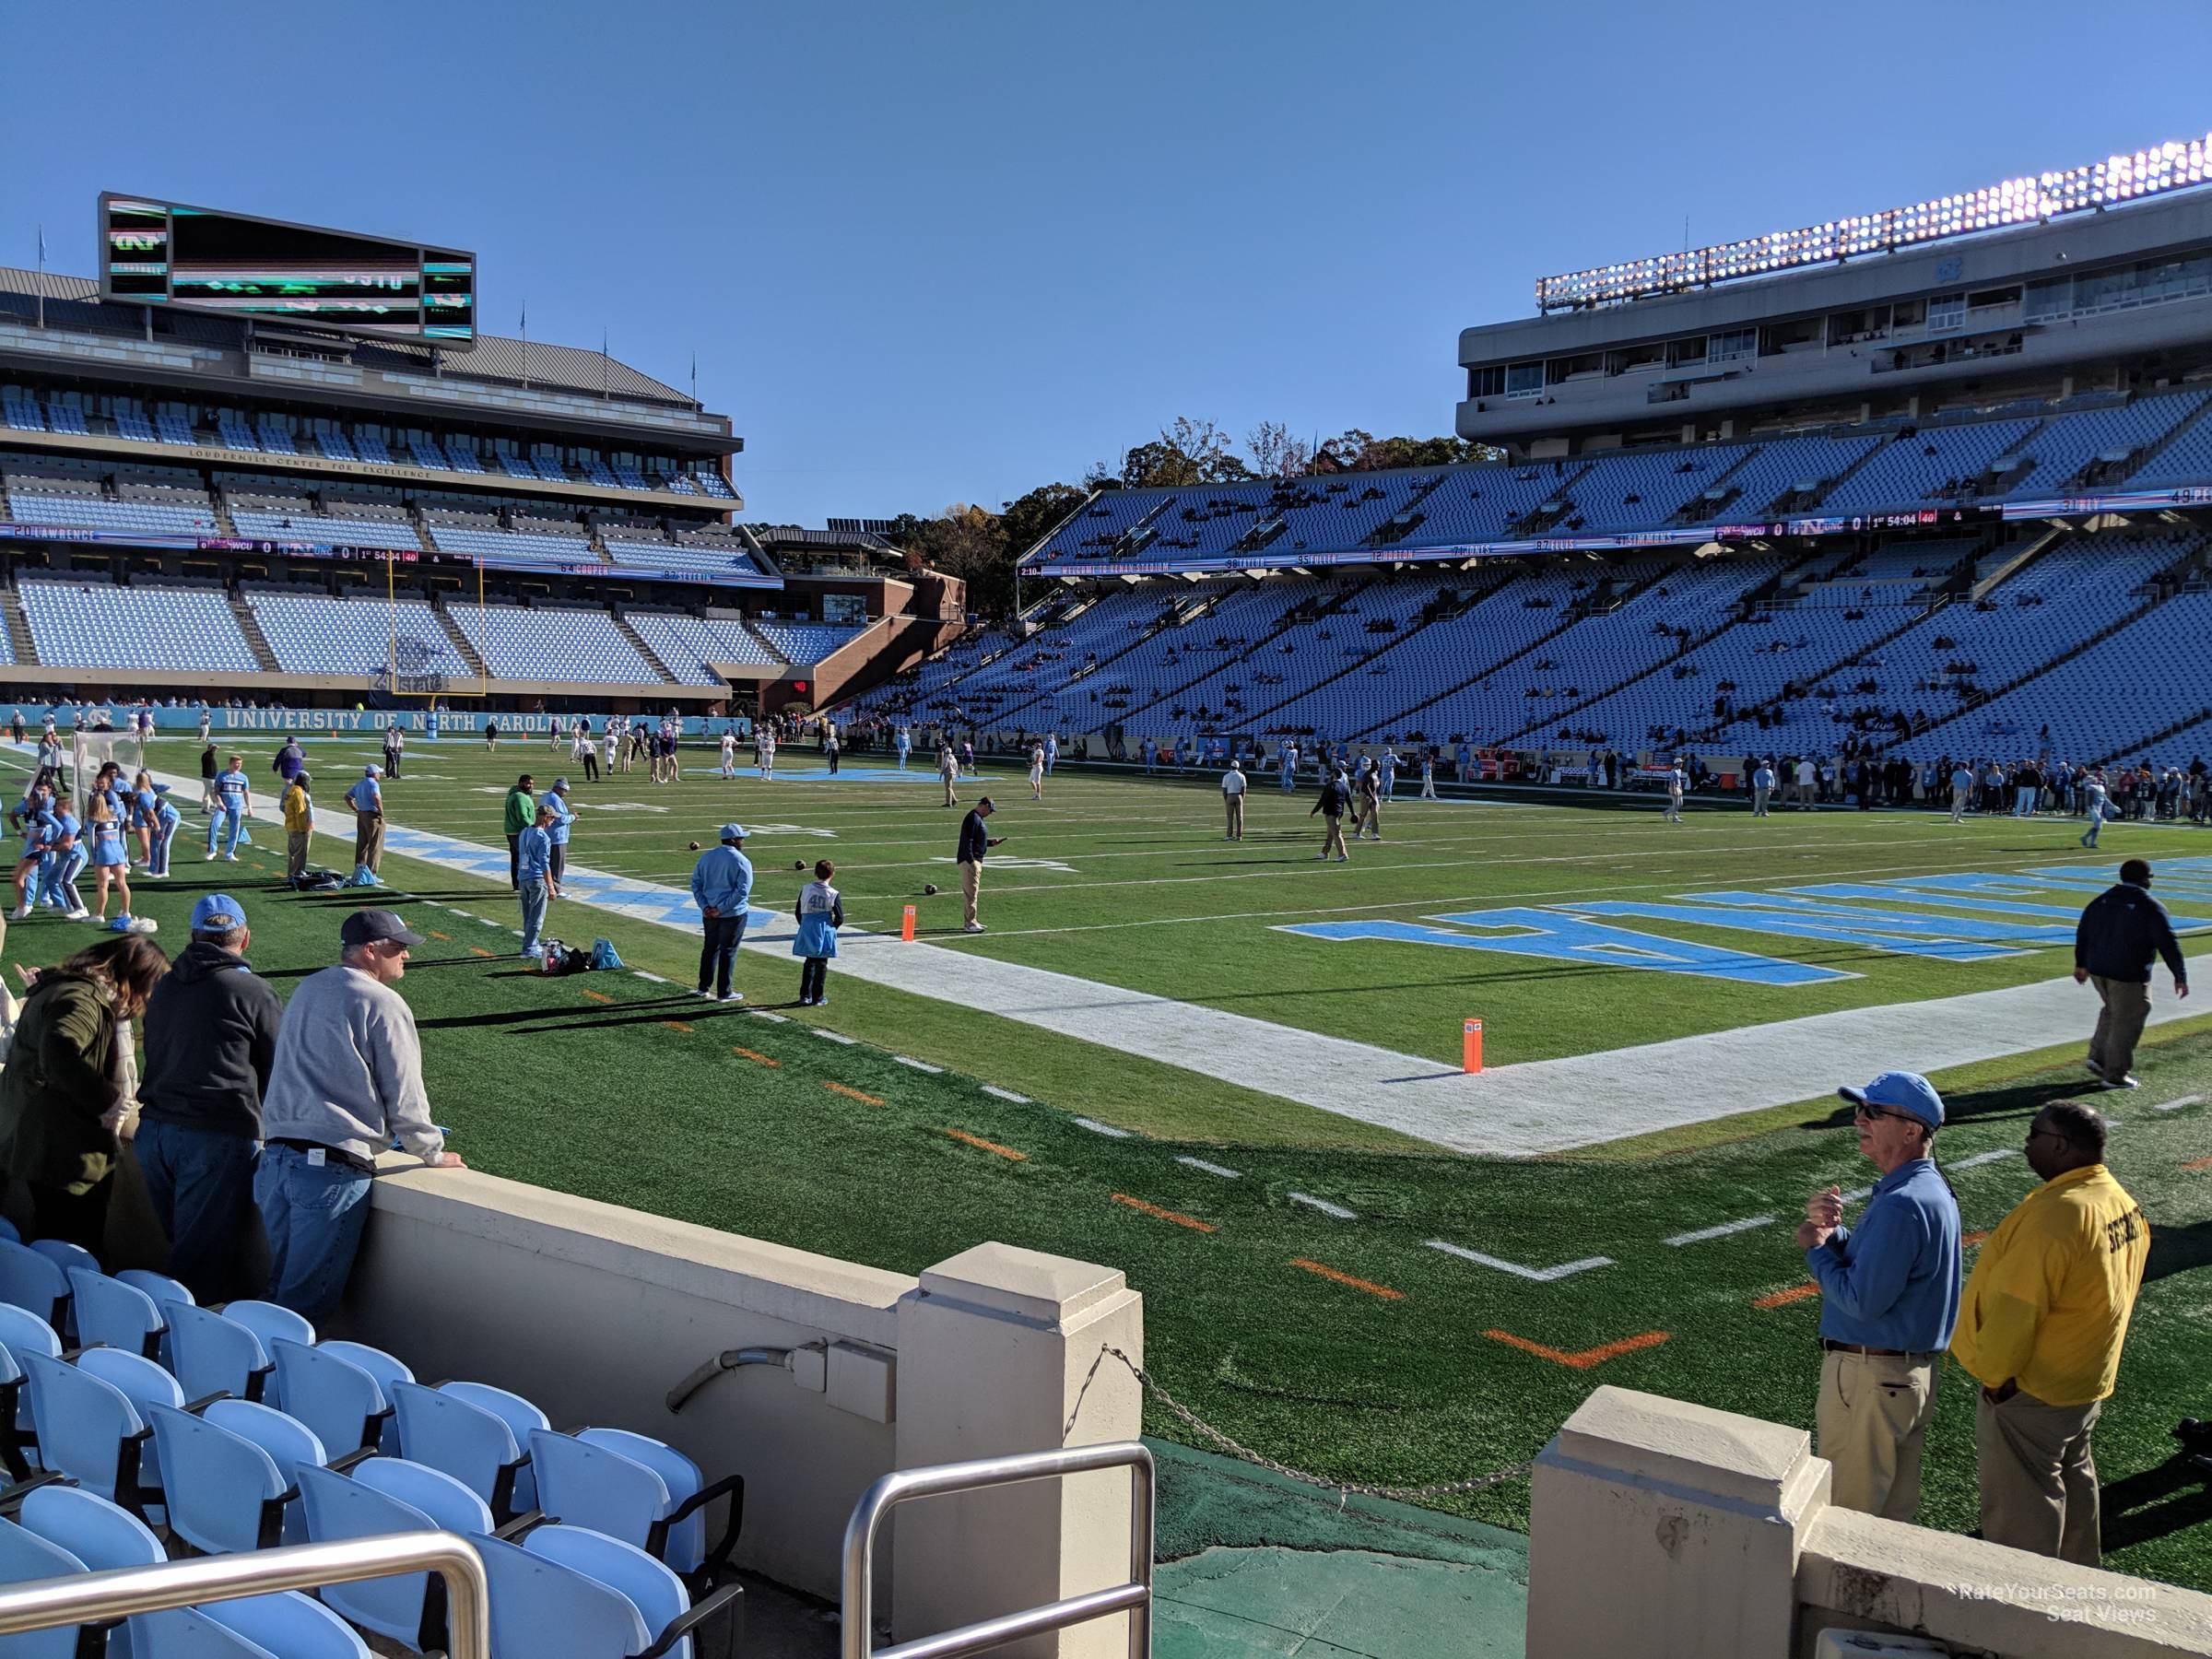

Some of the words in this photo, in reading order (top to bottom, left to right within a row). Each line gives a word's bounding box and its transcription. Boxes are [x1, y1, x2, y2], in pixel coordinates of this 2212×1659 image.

[190, 449, 267, 463] LOUDERMILK
[276, 458, 322, 468] CENTER
[332, 463, 353, 471] FOR
[363, 465, 430, 478] EXCELLENCE
[2171, 488, 2191, 504] 49
[1746, 526, 1766, 536] WCU
[1774, 524, 1783, 536] 0
[1824, 521, 1843, 531] UNC
[1853, 517, 1861, 530] 0
[1888, 514, 1916, 526] 54:04
[1922, 513, 1934, 523] 40
[1954, 511, 1962, 521] &
[14, 525, 31, 536] 20
[34, 527, 95, 541] LAWRENCE
[1628, 533, 1673, 546] SIMMONS
[1464, 545, 1490, 556] JONES
[1536, 540, 1549, 551] 87
[1550, 539, 1574, 550] ELLIS
[232, 542, 253, 551] WCU
[263, 542, 272, 553] 0
[313, 545, 334, 556] UNC
[342, 547, 350, 559] 0
[432, 555, 440, 563] &
[1298, 555, 1309, 565] 95
[1310, 553, 1336, 565] FULLER
[560, 564, 574, 573] 64
[576, 565, 608, 576] COOPER
[1062, 565, 1097, 576] WELCOME
[1099, 565, 1109, 574] TO
[1110, 563, 1134, 574] KENAN
[1136, 562, 1170, 572] STADIUM
[1239, 558, 1265, 569] TAYLOR
[1021, 567, 1037, 576] 2:10
[226, 711, 362, 730] UNIVERSITY
[374, 712, 398, 730] OF
[412, 712, 477, 731] NRTH
